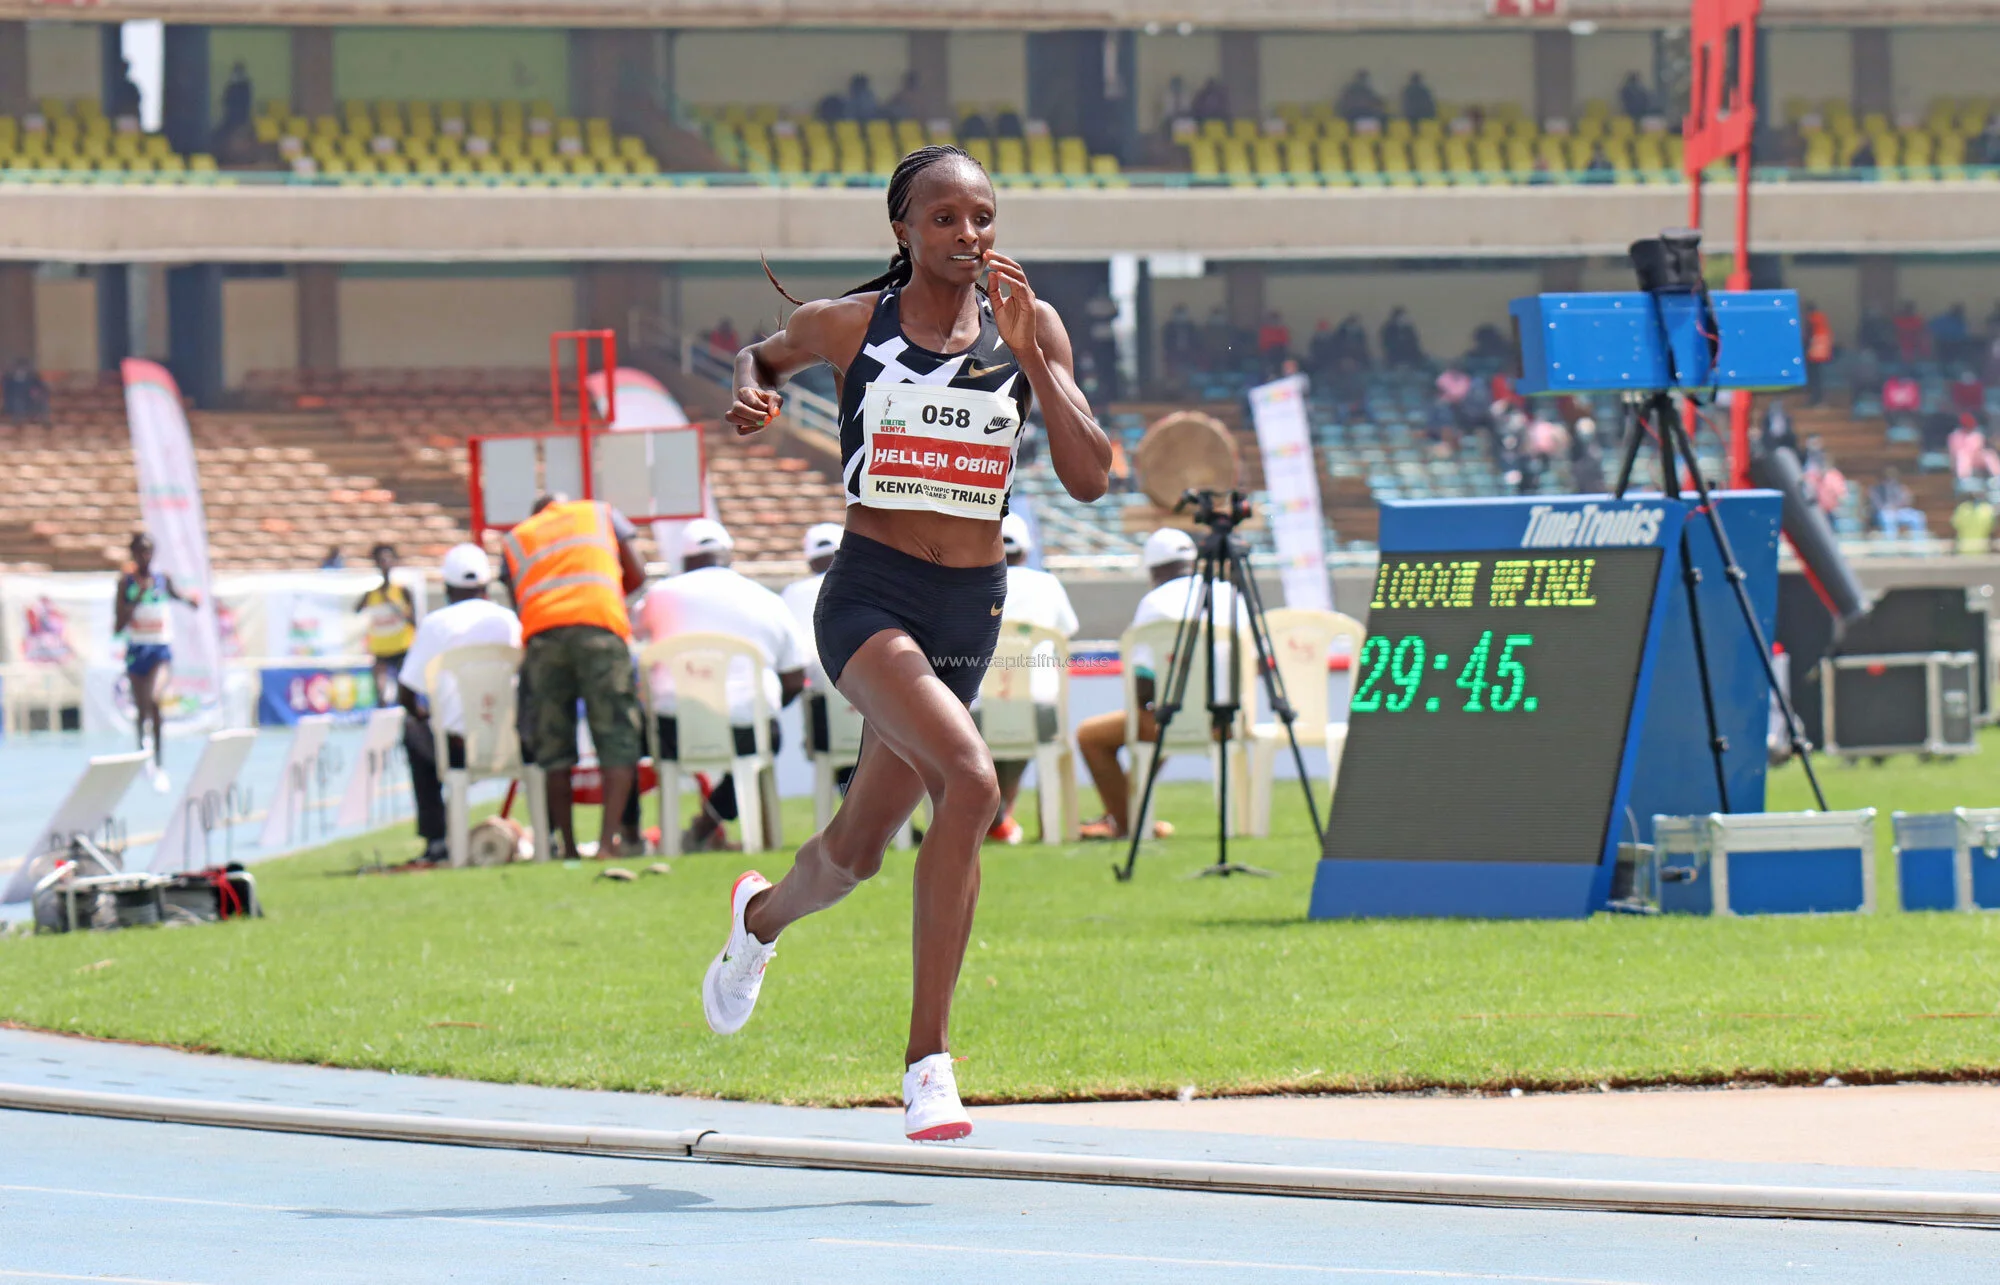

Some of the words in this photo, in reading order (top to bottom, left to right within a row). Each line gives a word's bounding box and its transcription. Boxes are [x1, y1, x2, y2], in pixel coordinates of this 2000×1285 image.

[880, 419, 906, 427] ATHLETICS
[921, 404, 971, 429] 058
[989, 415, 1012, 428] NIKE
[873, 448, 949, 469] HELLEN
[954, 455, 1005, 475] OBIRI
[875, 480, 924, 495] KENYA
[951, 488, 997, 505] TRIALS
[923, 484, 950, 494] OLYMPIC
[925, 490, 947, 500] GAMES
[1520, 503, 1666, 548] TimeTronics
